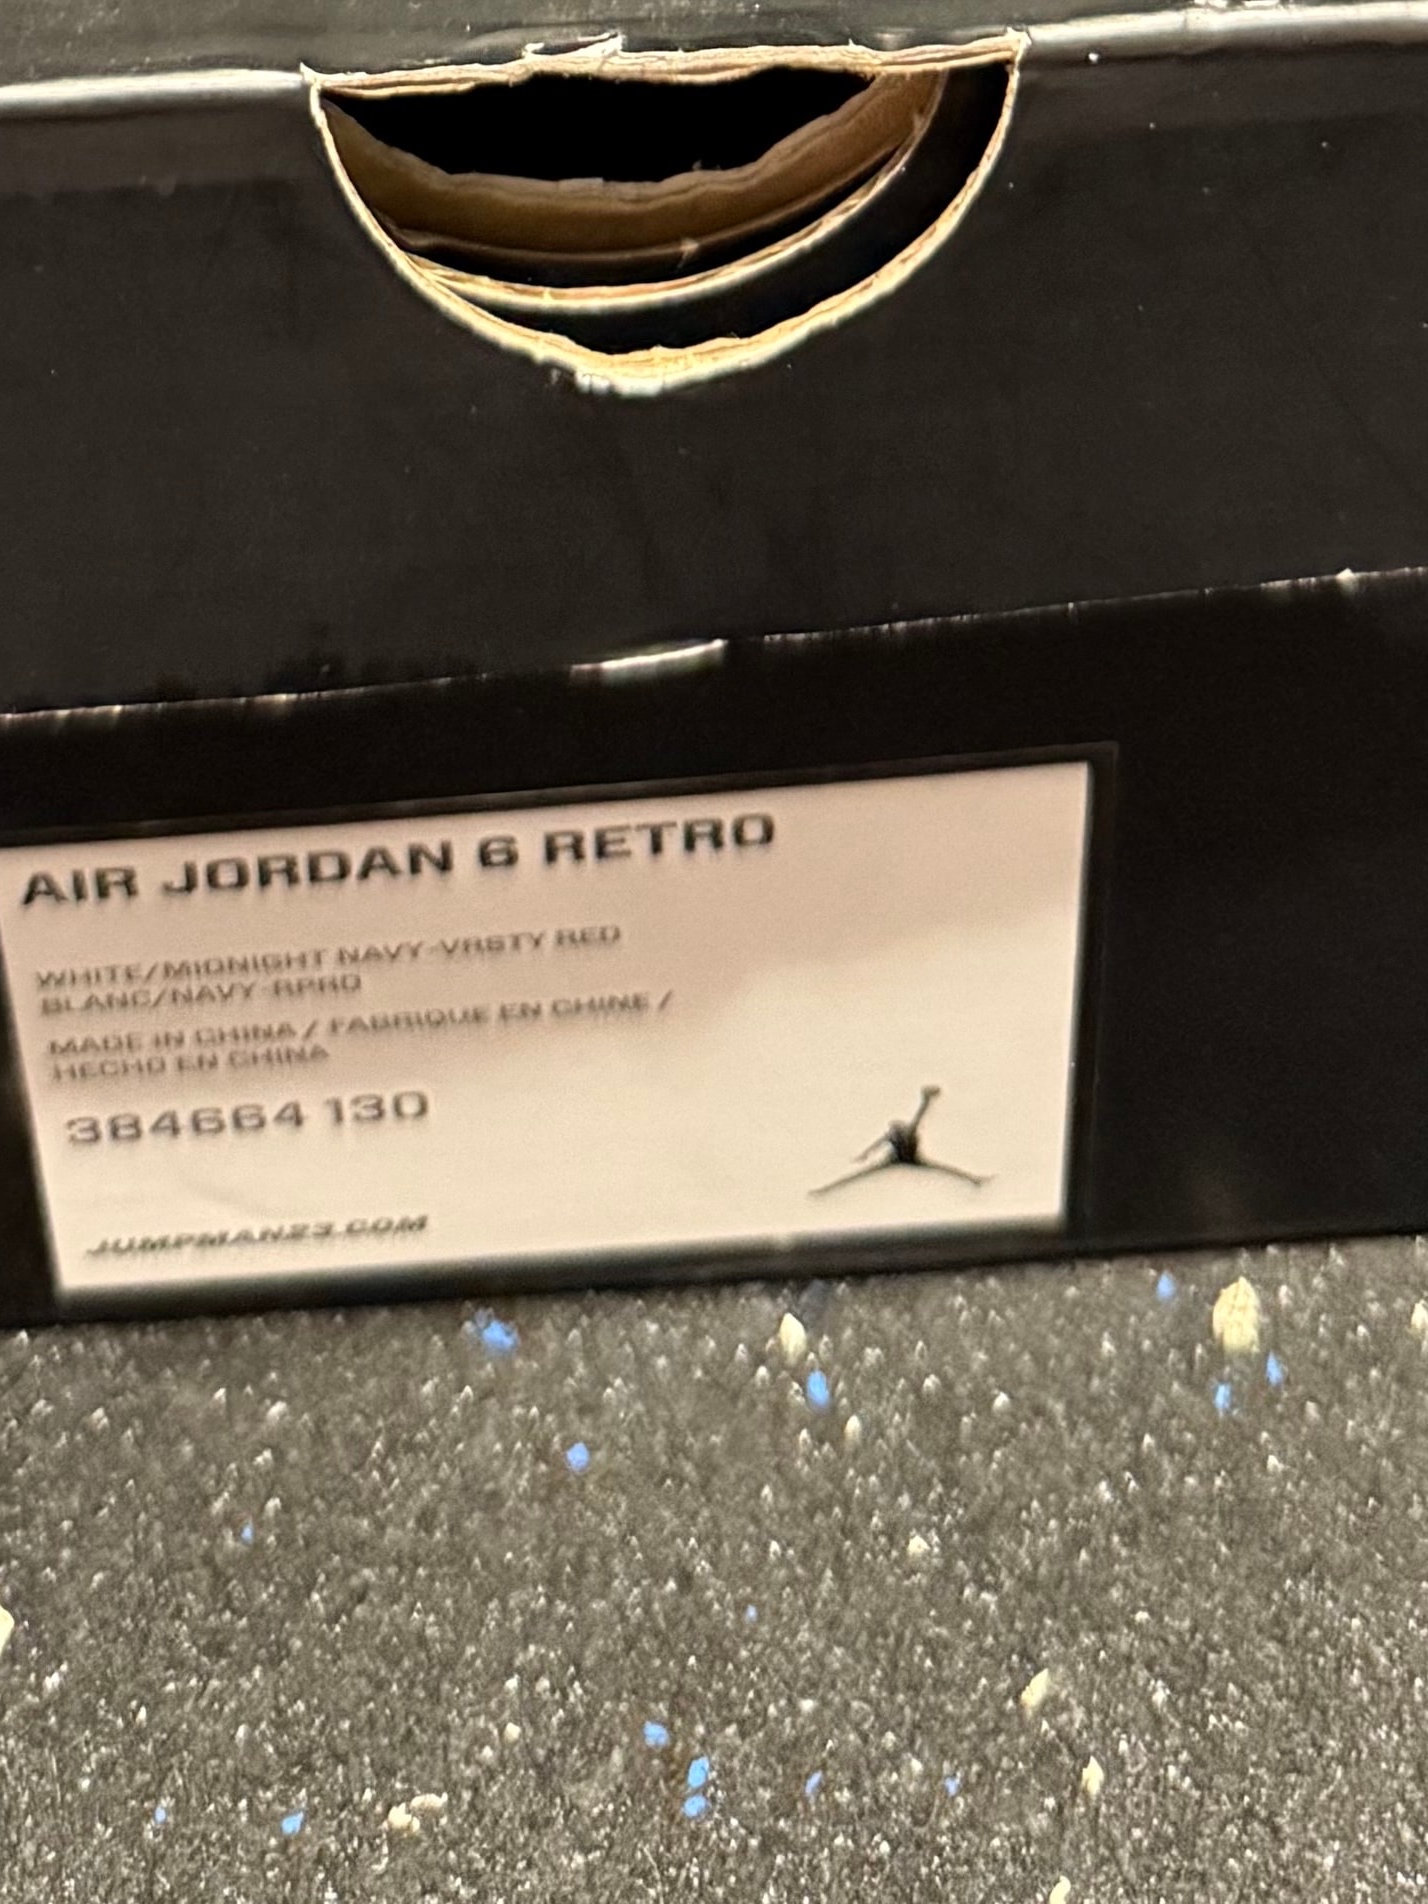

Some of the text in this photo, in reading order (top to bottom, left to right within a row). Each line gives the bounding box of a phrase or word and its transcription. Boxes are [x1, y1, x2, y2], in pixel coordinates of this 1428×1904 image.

[22, 811, 777, 908] AIR JORDAN 6 RETRO
[36, 949, 327, 991] WHITE/MIDNIGHT
[555, 923, 622, 949] RED
[49, 1034, 141, 1056] MADE
[152, 1028, 186, 1051] IN
[194, 1021, 298, 1045] CHINA
[329, 1004, 489, 1035] FABRIQUE
[498, 1000, 543, 1022] EN
[550, 992, 649, 1020] CHINE
[52, 1043, 330, 1081] HECHO EN CHINA
[67, 1088, 429, 1144] 384664 130
[85, 1214, 429, 1258] JUMPMAN23.COM
